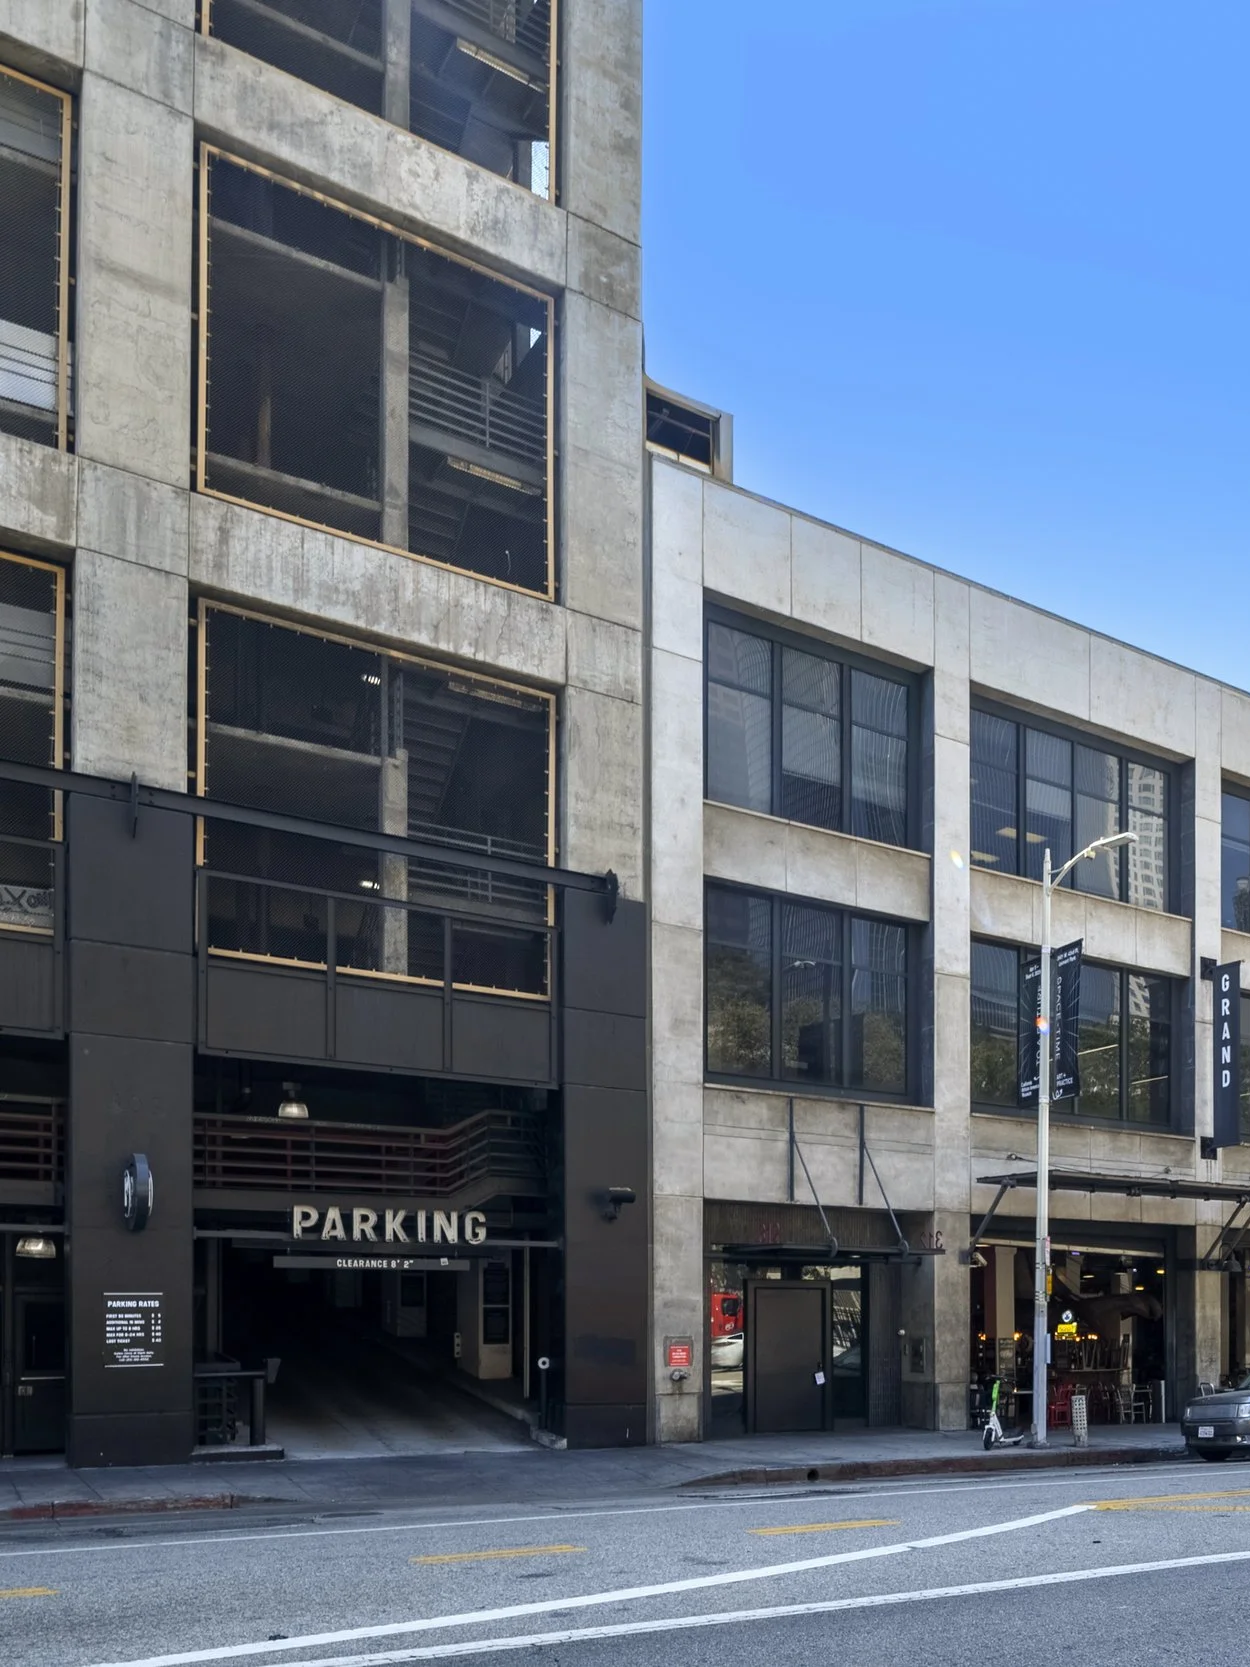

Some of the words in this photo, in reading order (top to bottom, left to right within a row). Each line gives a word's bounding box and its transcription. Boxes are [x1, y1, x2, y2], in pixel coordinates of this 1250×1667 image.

[1221, 973, 1231, 1088] GRAND
[293, 1204, 487, 1245] PARKING
[336, 1258, 388, 1269] CLEARANCE
[390, 1259, 400, 1268] 8'
[403, 1259, 414, 1269] 2"
[107, 1300, 138, 1308] PARKING
[138, 1300, 160, 1308] RATES
